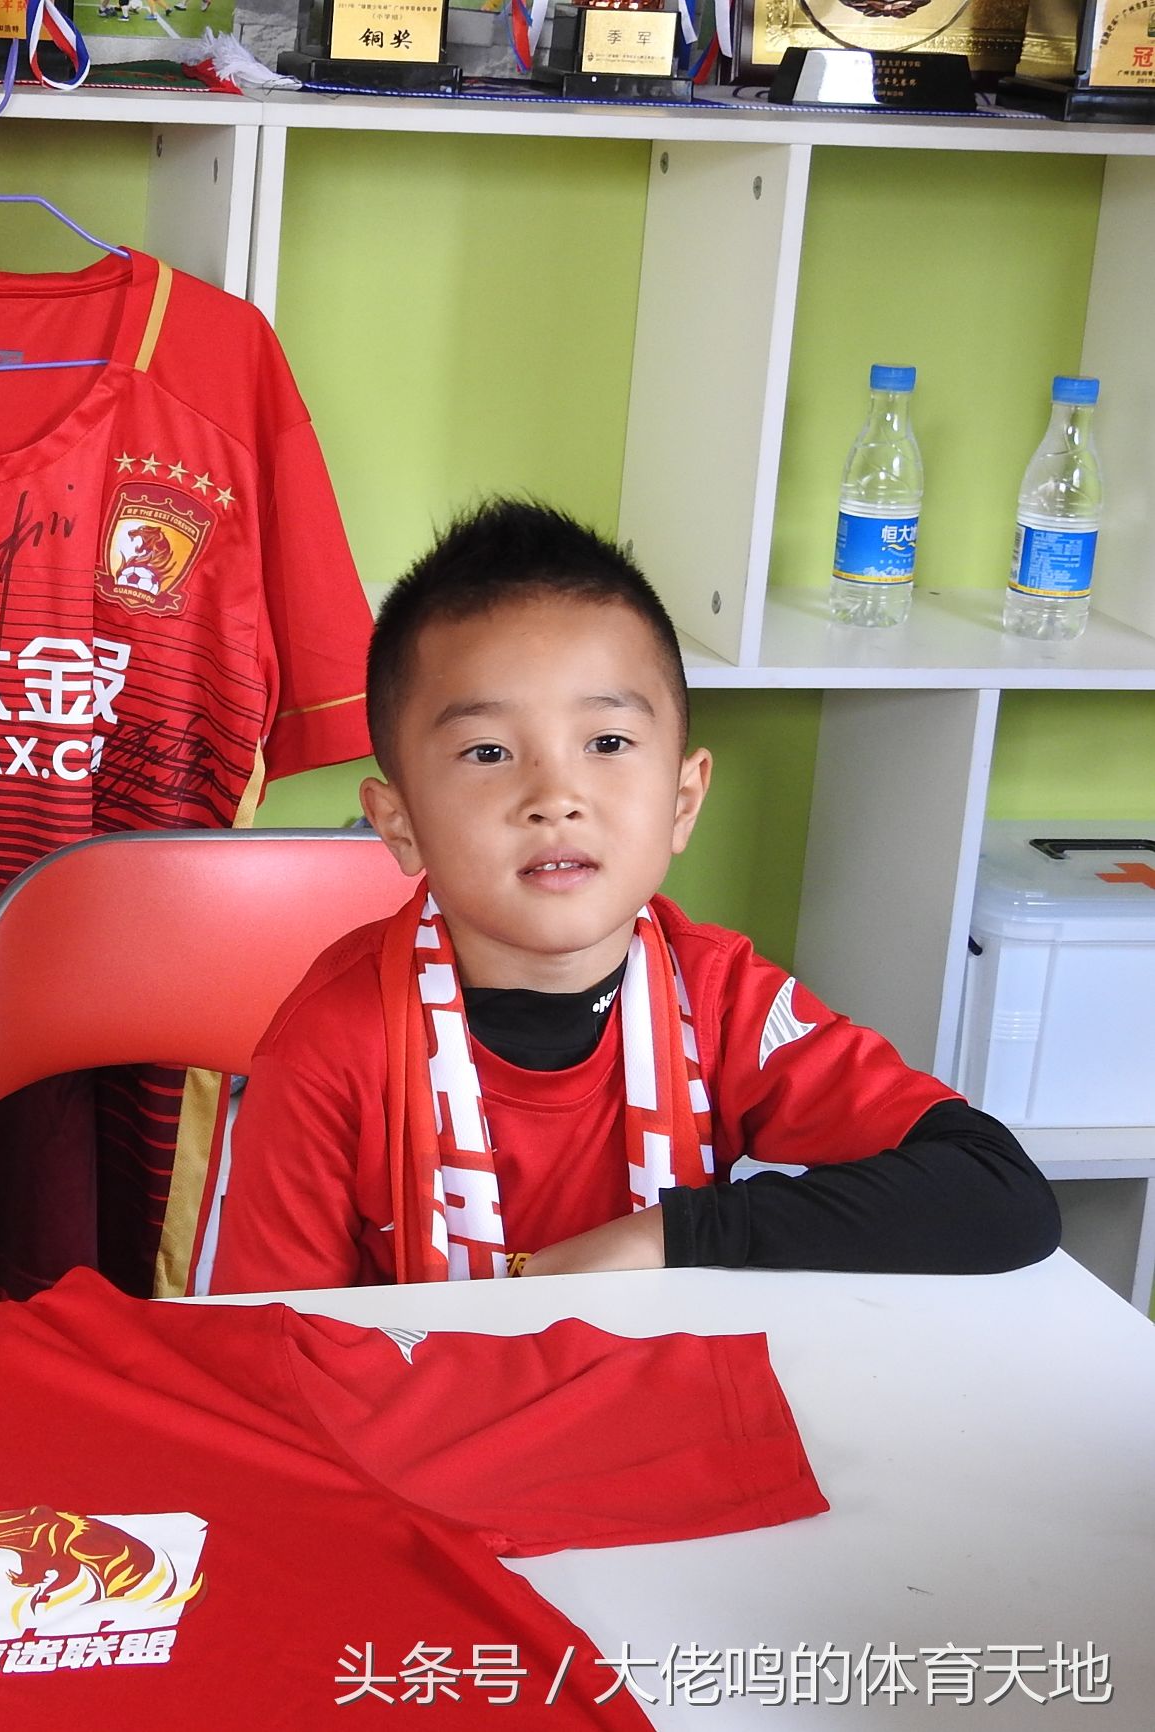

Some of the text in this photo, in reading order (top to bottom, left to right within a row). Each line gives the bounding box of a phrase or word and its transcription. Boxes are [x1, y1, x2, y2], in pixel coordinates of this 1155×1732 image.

[359, 28, 412, 49] 铜奖
[607, 29, 652, 47] 季军
[1133, 47, 1154, 67] 冠
[113, 587, 156, 604] GUANGZHOU
